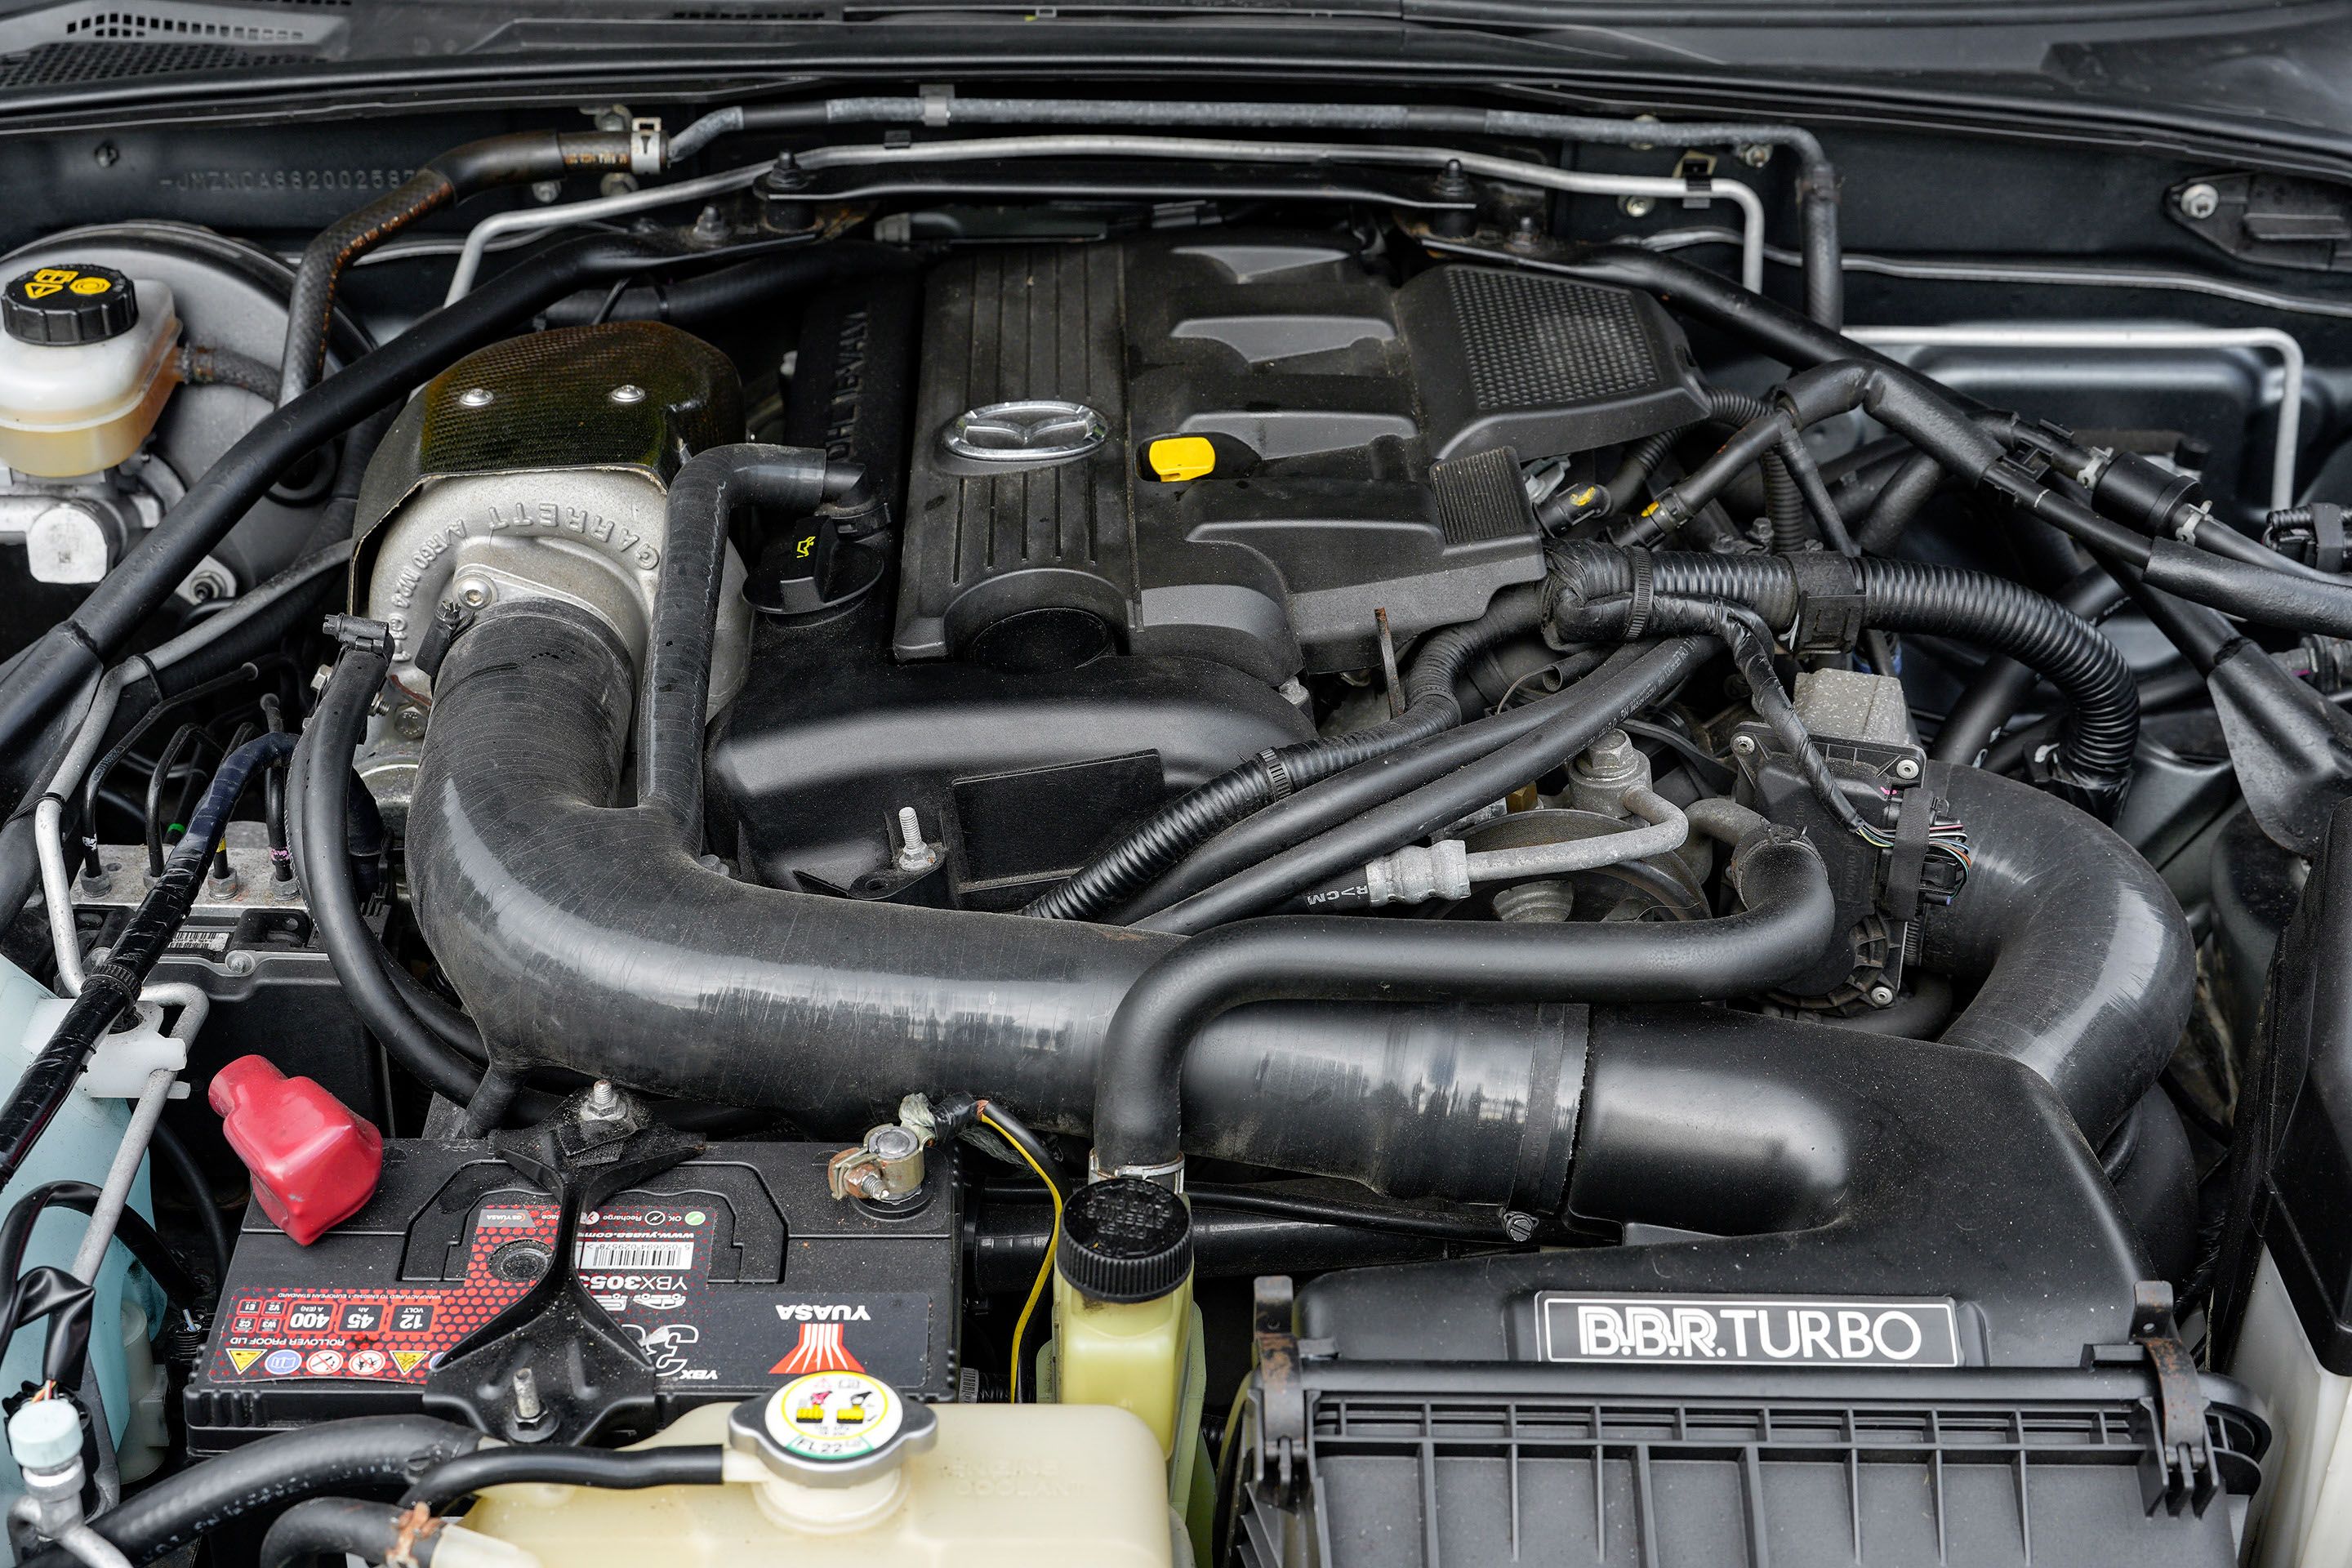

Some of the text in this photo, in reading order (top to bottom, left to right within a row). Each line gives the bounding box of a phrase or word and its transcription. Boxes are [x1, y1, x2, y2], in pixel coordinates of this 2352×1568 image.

[488, 501, 660, 572] GARRETT
[602, 1214, 643, 1222] Recharge
[290, 1312, 330, 1328] 400
[774, 1304, 871, 1321] YUASA
[238, 1320, 252, 1328] C2
[346, 1313, 375, 1329] 45
[399, 1313, 424, 1330] 12
[229, 1337, 345, 1347] ROLLOVER PROOF LID
[679, 1370, 718, 1380] YBX
